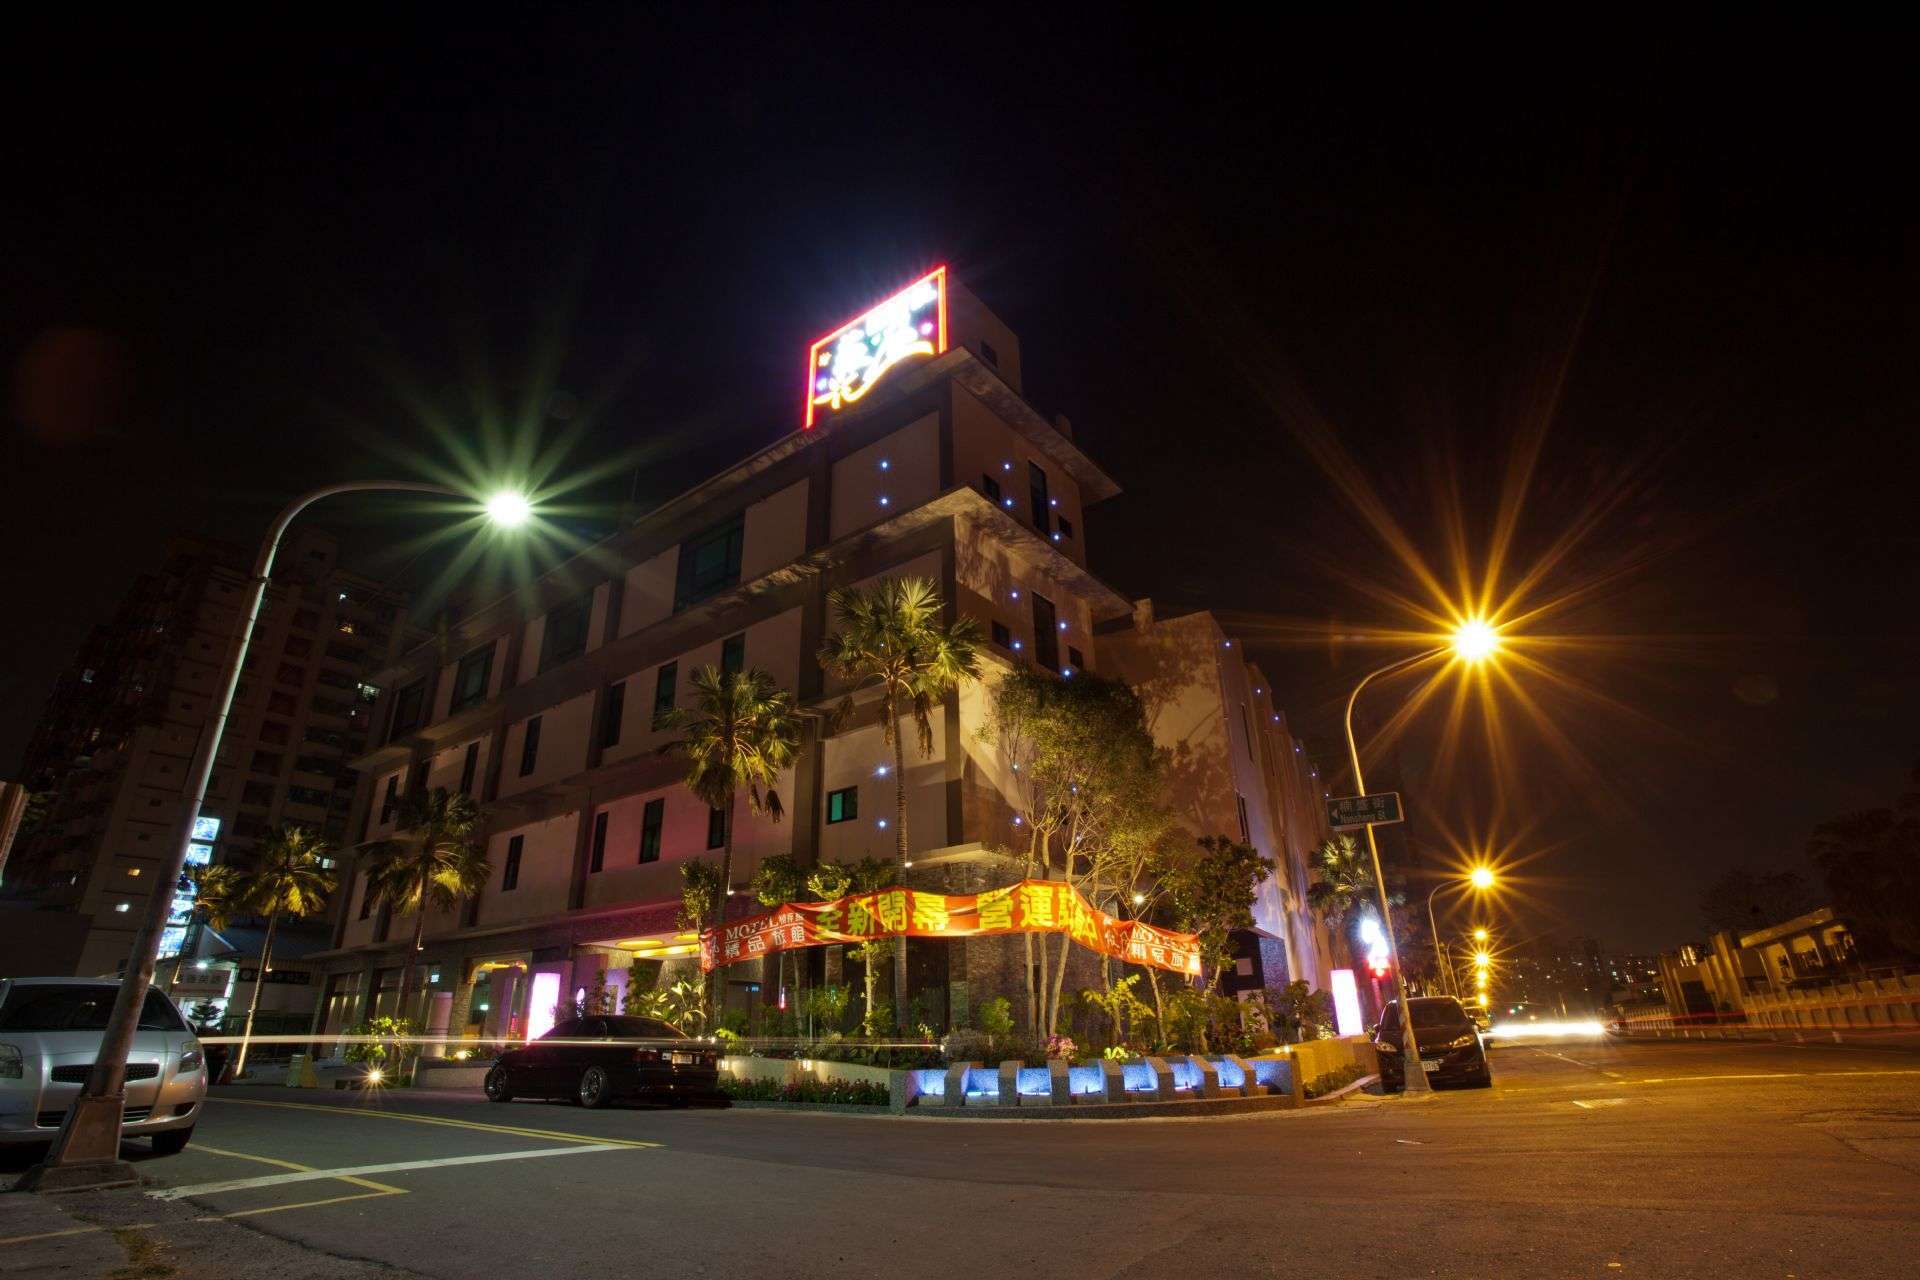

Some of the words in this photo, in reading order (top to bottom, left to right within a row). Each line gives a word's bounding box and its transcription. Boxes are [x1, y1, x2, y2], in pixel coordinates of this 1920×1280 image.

[726, 916, 779, 941] MOTEL
[815, 889, 950, 941] 全新開幕
[725, 926, 806, 958] 精品旅館
